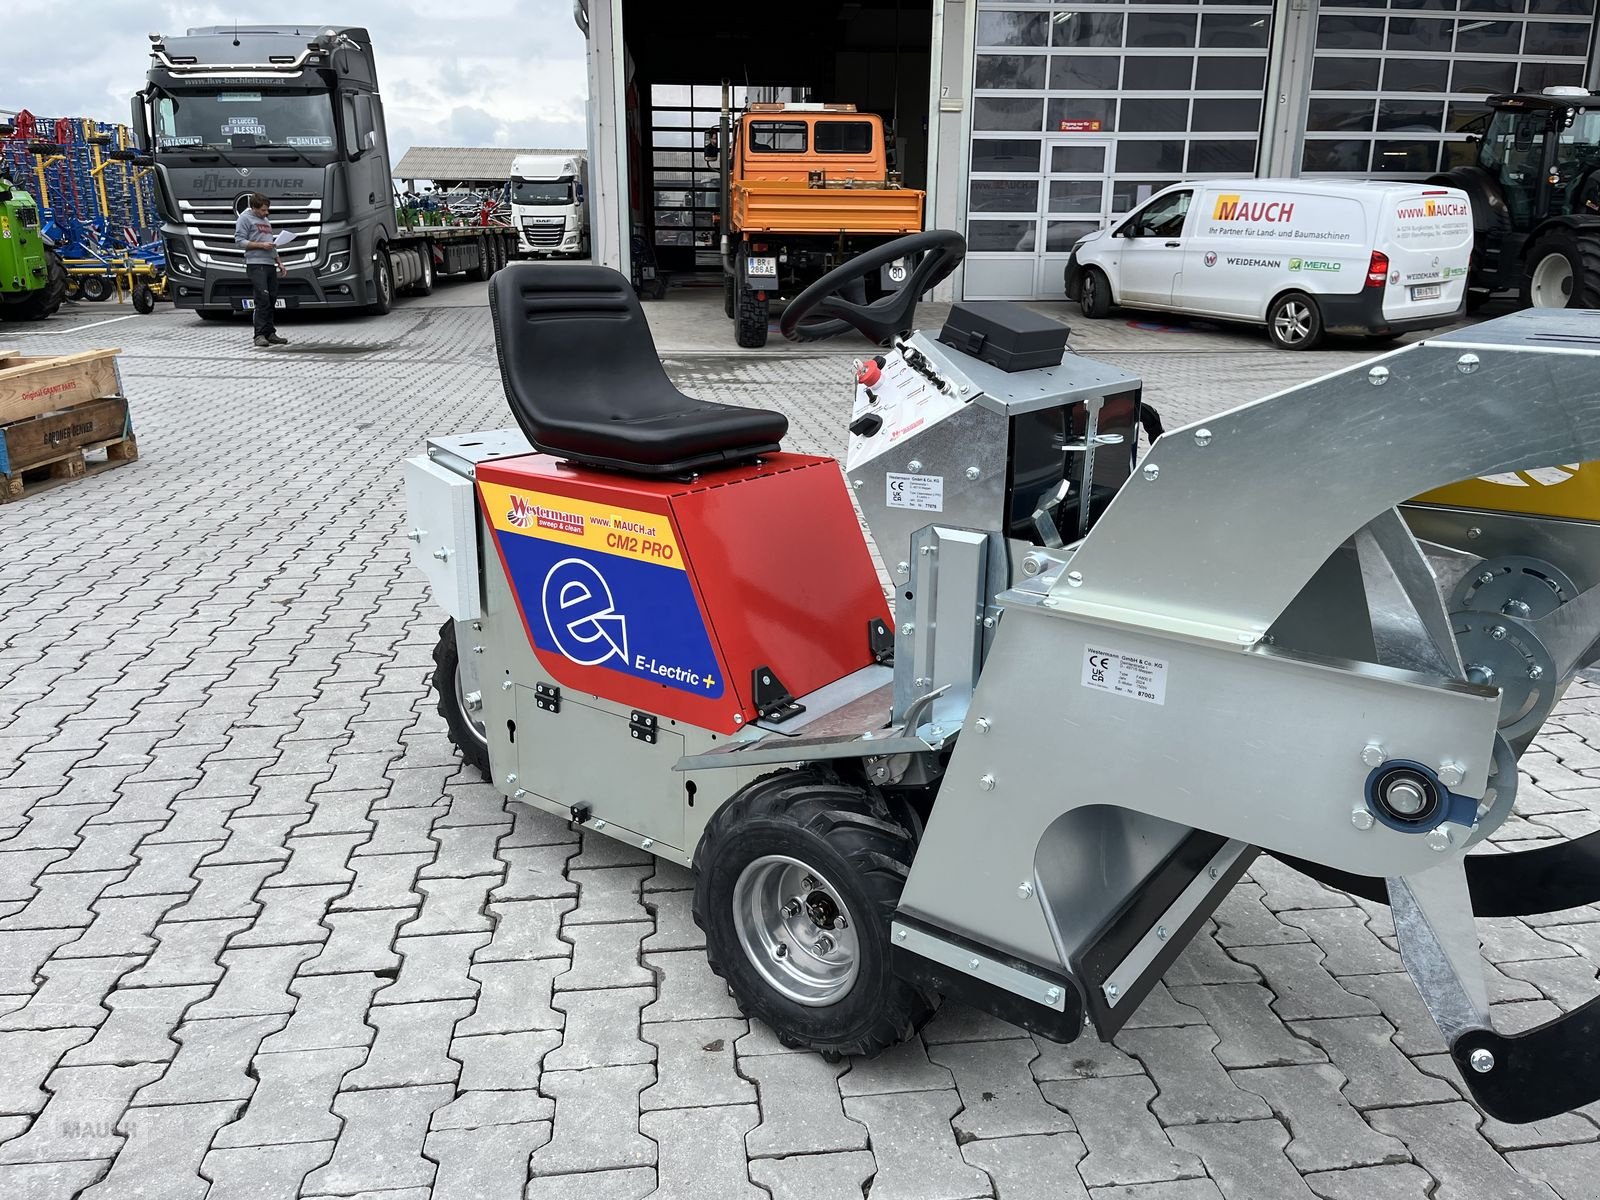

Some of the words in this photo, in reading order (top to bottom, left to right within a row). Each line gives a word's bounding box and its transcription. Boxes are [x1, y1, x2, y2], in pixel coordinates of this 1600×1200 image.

[943, 87, 948, 97] 7
[1280, 95, 1286, 103] 5
[233, 126, 262, 134] ALESSIO
[163, 137, 195, 147] NATASCHA
[296, 138, 322, 146] DANIEL
[1218, 201, 1294, 222] MAUCH
[1208, 227, 1218, 235] Ihr
[1219, 227, 1243, 236] Partner
[1245, 228, 1255, 236] für
[1257, 229, 1276, 237] Land-
[1278, 230, 1293, 238] und
[1294, 230, 1350, 240] Baumaschinen
[1226, 257, 1281, 268] WEIDEMANN
[1303, 261, 1341, 270] MERLO
[892, 268, 903, 279] 80
[22, 389, 43, 401] Original
[510, 495, 584, 525] Westermann
[538, 520, 558, 529] sweep
[606, 532, 637, 553] CM2
[641, 540, 673, 560] PRO
[1087, 647, 1120, 659] Westermann
[1121, 655, 1138, 664] GmbH
[635, 654, 699, 686] E-Lectric
[1137, 691, 1155, 700] 87003
